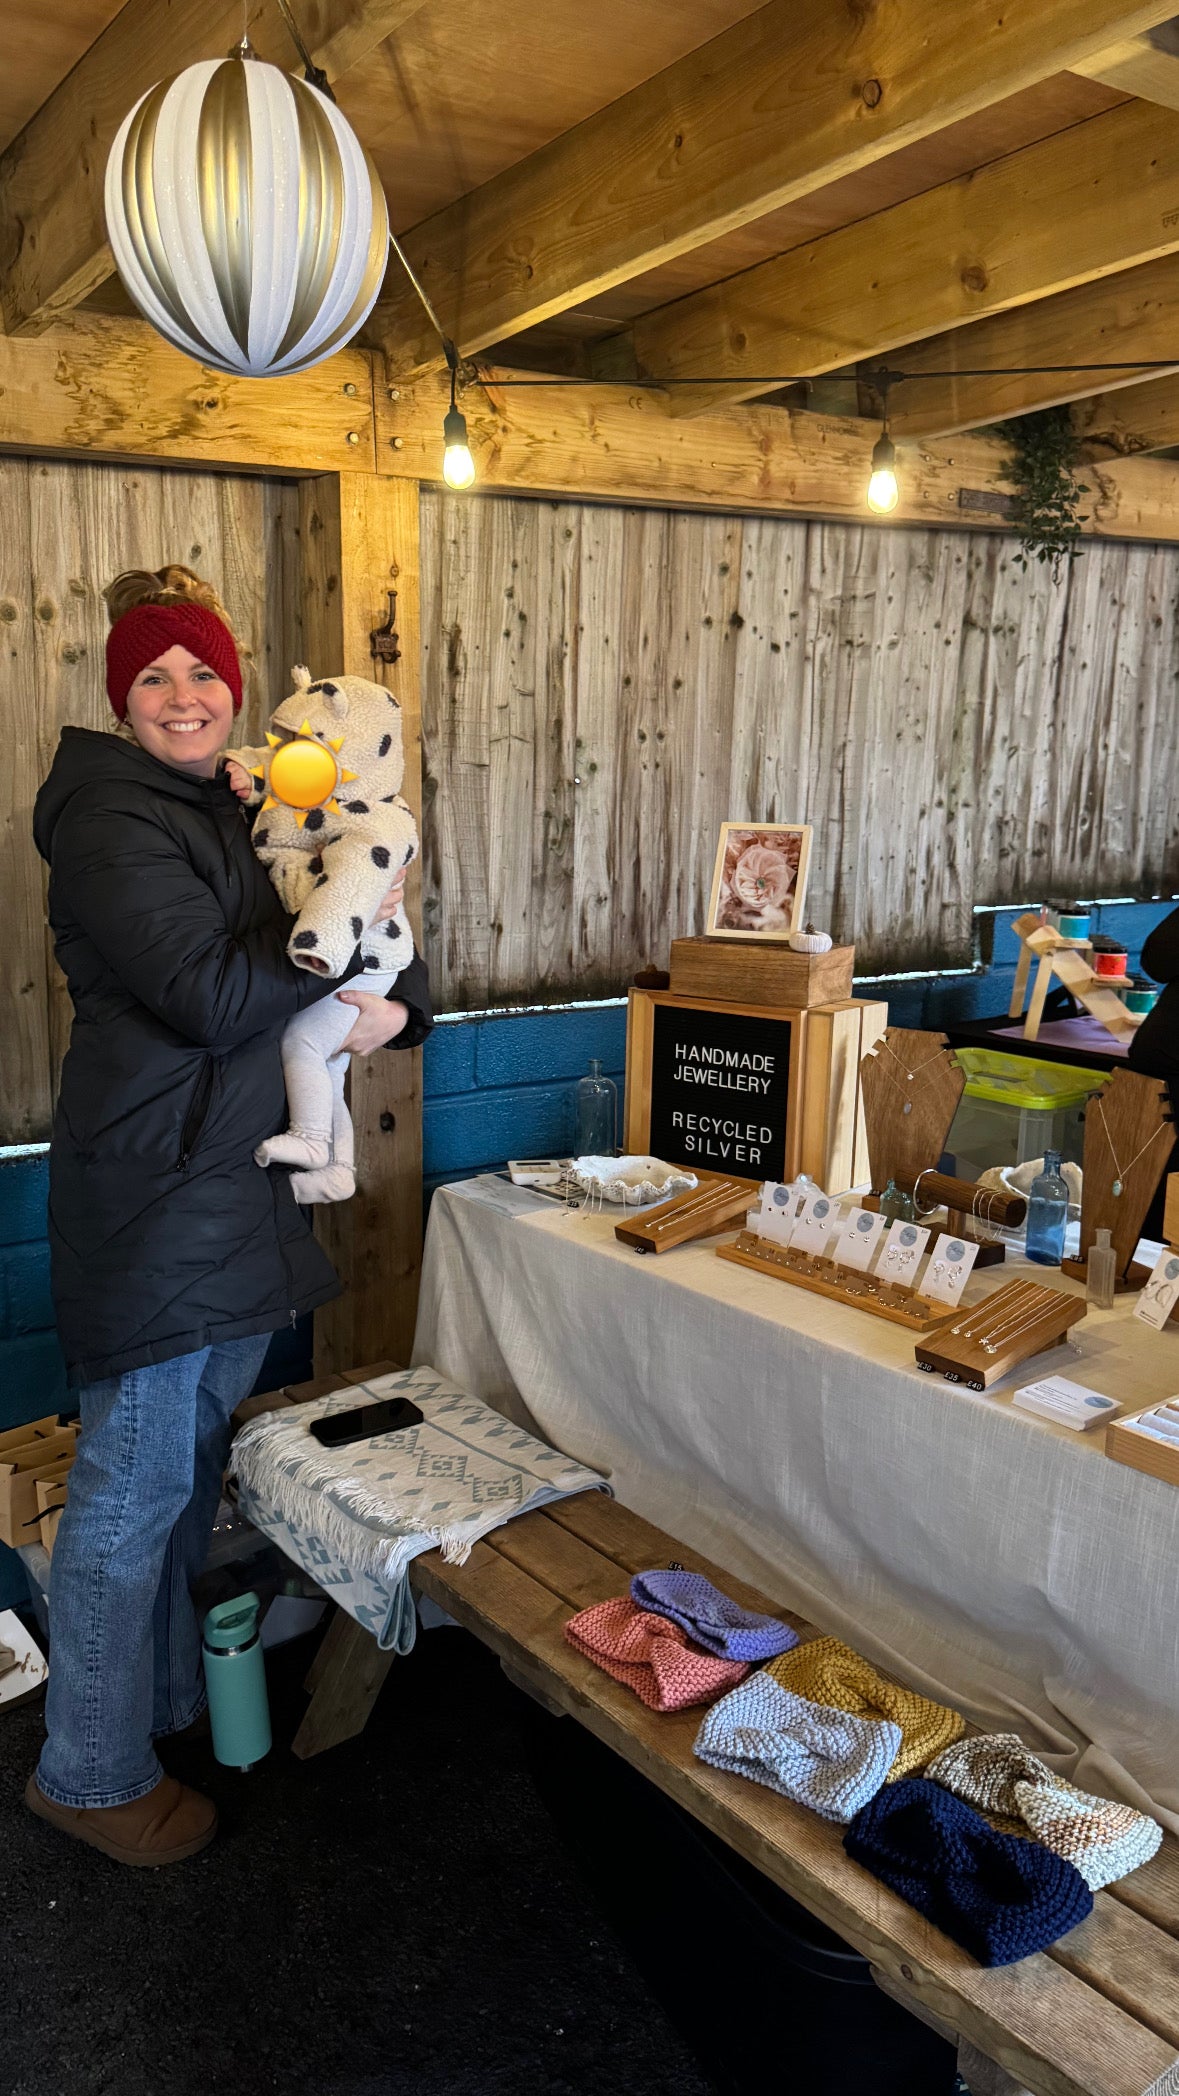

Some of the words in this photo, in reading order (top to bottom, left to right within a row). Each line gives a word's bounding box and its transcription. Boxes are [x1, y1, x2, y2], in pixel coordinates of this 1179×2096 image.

[675, 1043, 775, 1073] HANDMADE
[673, 1064, 771, 1095] JEWELLERY
[672, 1111, 772, 1144] RECYCLED
[684, 1135, 761, 1165] SILVER
[918, 1361, 932, 1372] £30
[944, 1371, 958, 1382] £35
[967, 1380, 982, 1391] £40
